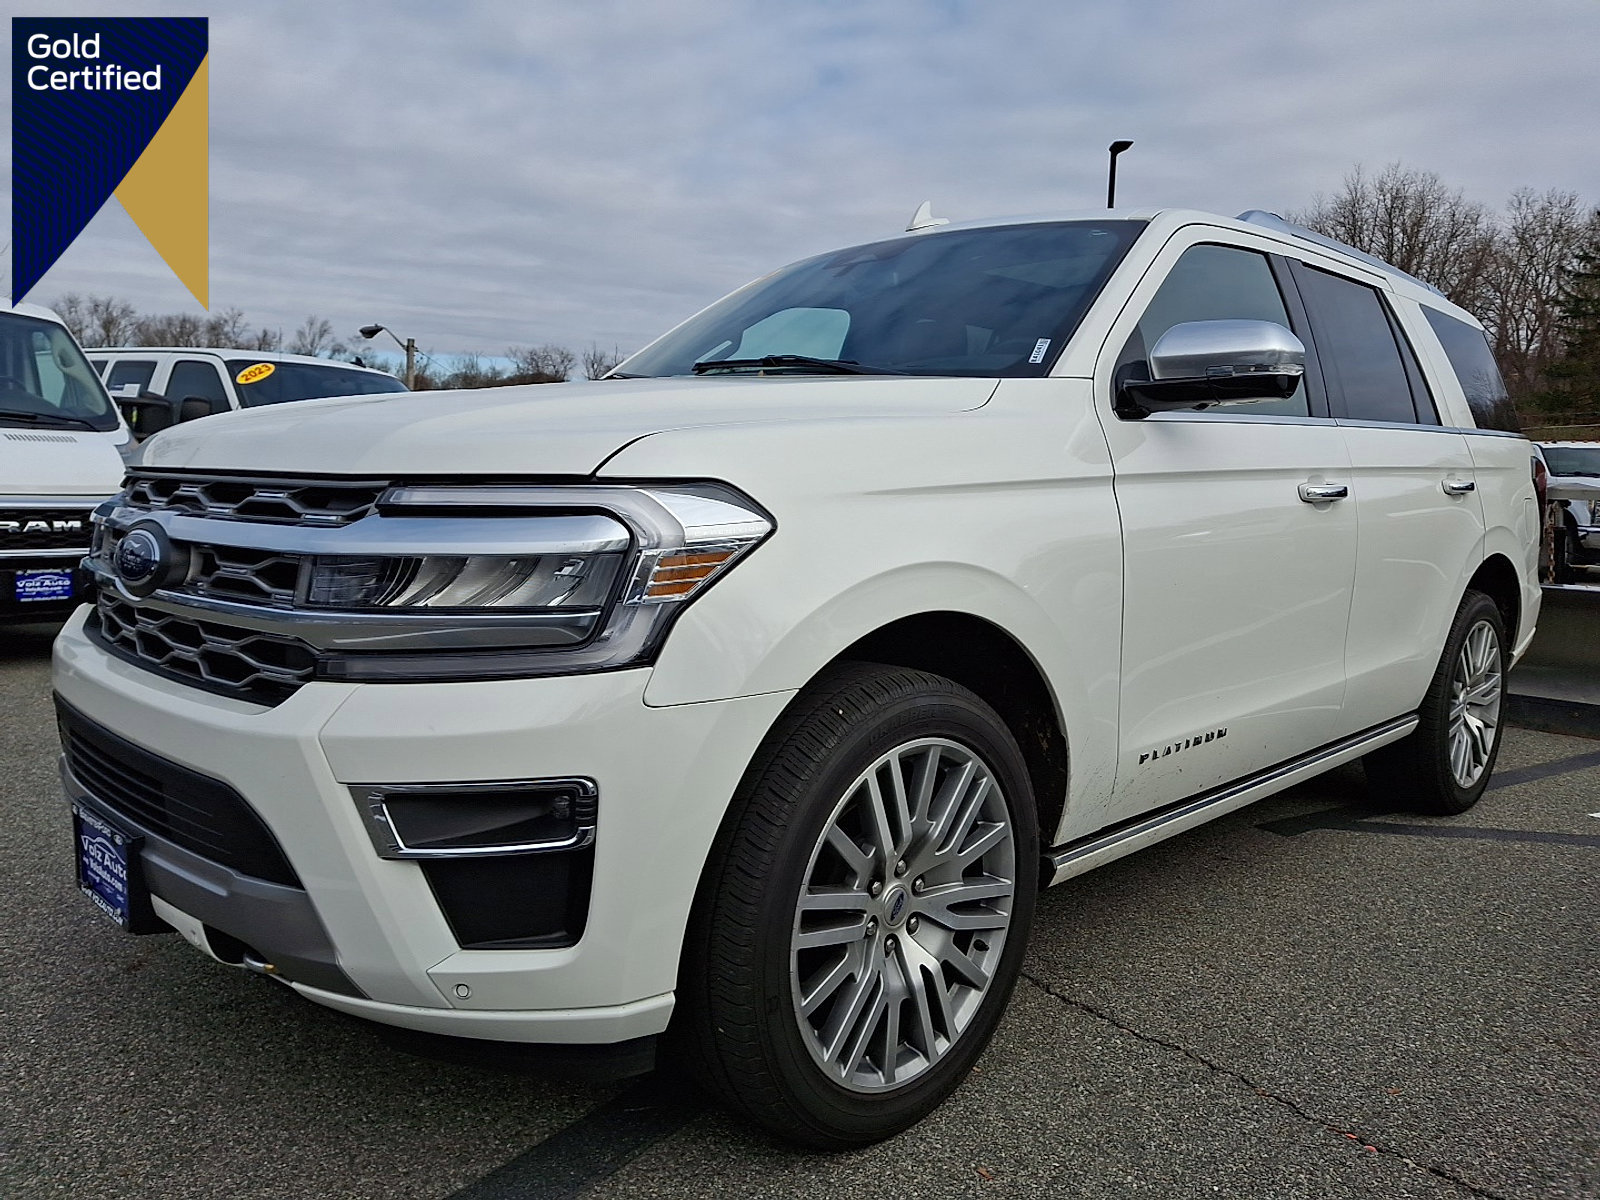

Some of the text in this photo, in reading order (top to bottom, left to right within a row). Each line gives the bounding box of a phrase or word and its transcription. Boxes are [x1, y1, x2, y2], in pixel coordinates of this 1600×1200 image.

[240, 364, 272, 381] 2023
[0, 521, 82, 533] RAM
[1138, 727, 1228, 765] PLATINUM
[81, 837, 103, 862] Volz
